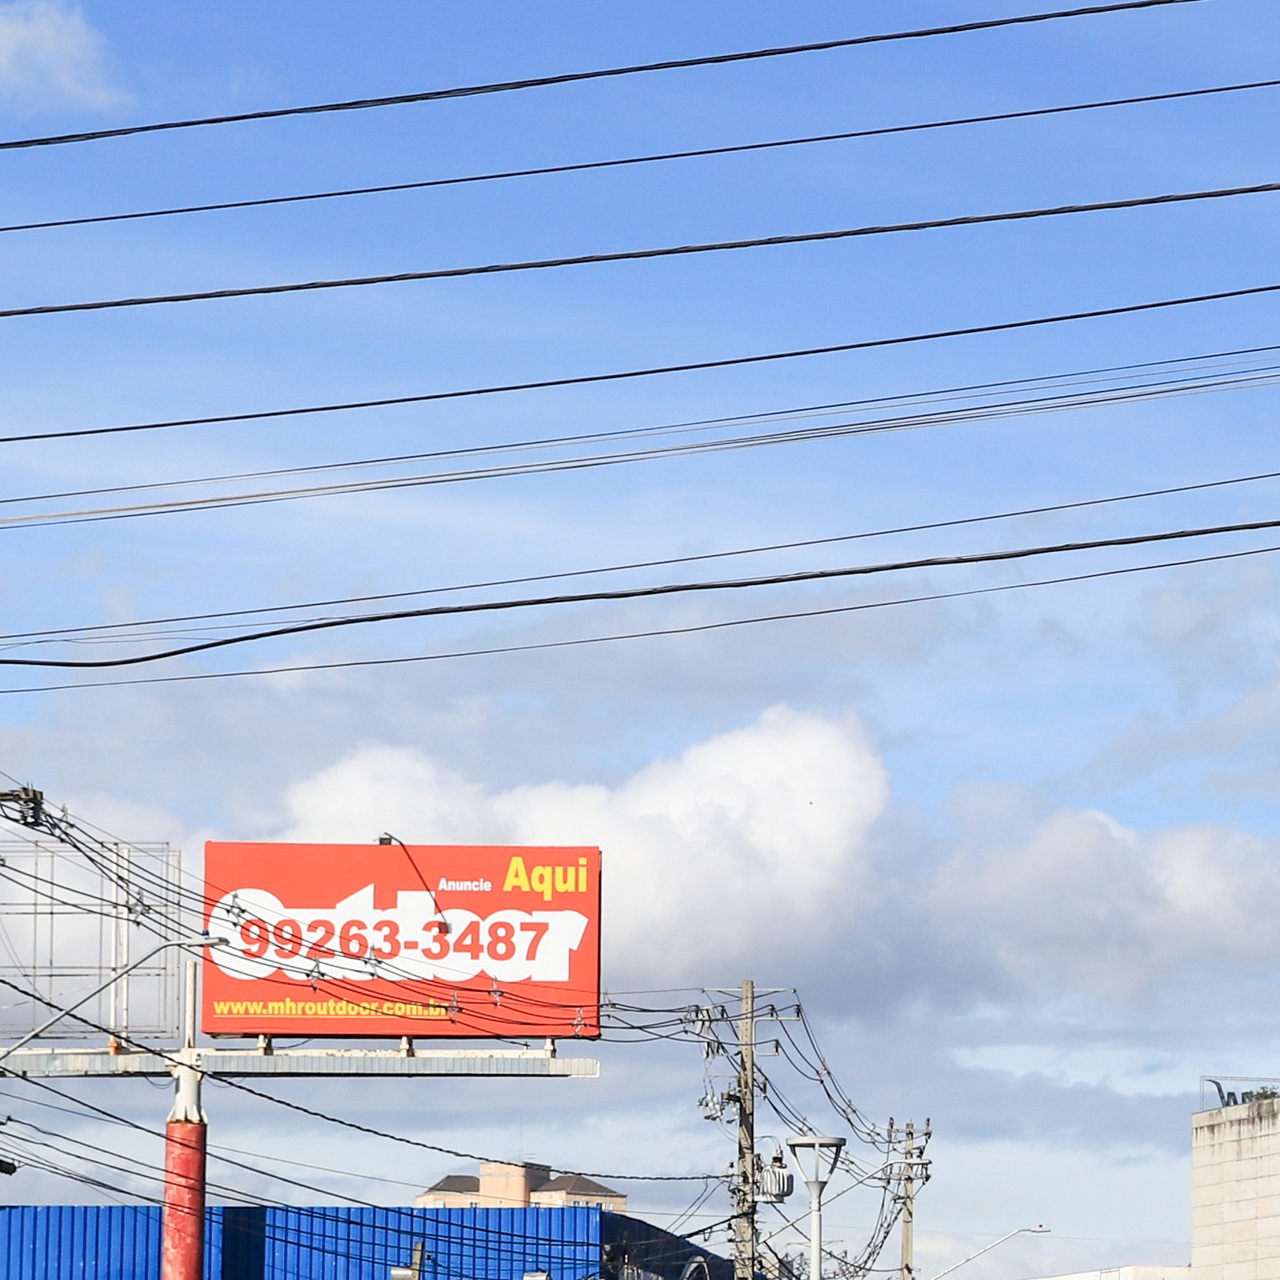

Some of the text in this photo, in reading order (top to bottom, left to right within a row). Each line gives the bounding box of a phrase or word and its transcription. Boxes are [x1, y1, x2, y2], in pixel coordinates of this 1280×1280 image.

[438, 856, 588, 901] Anuncie Aqui
[240, 918, 550, 962] 99263-3487
